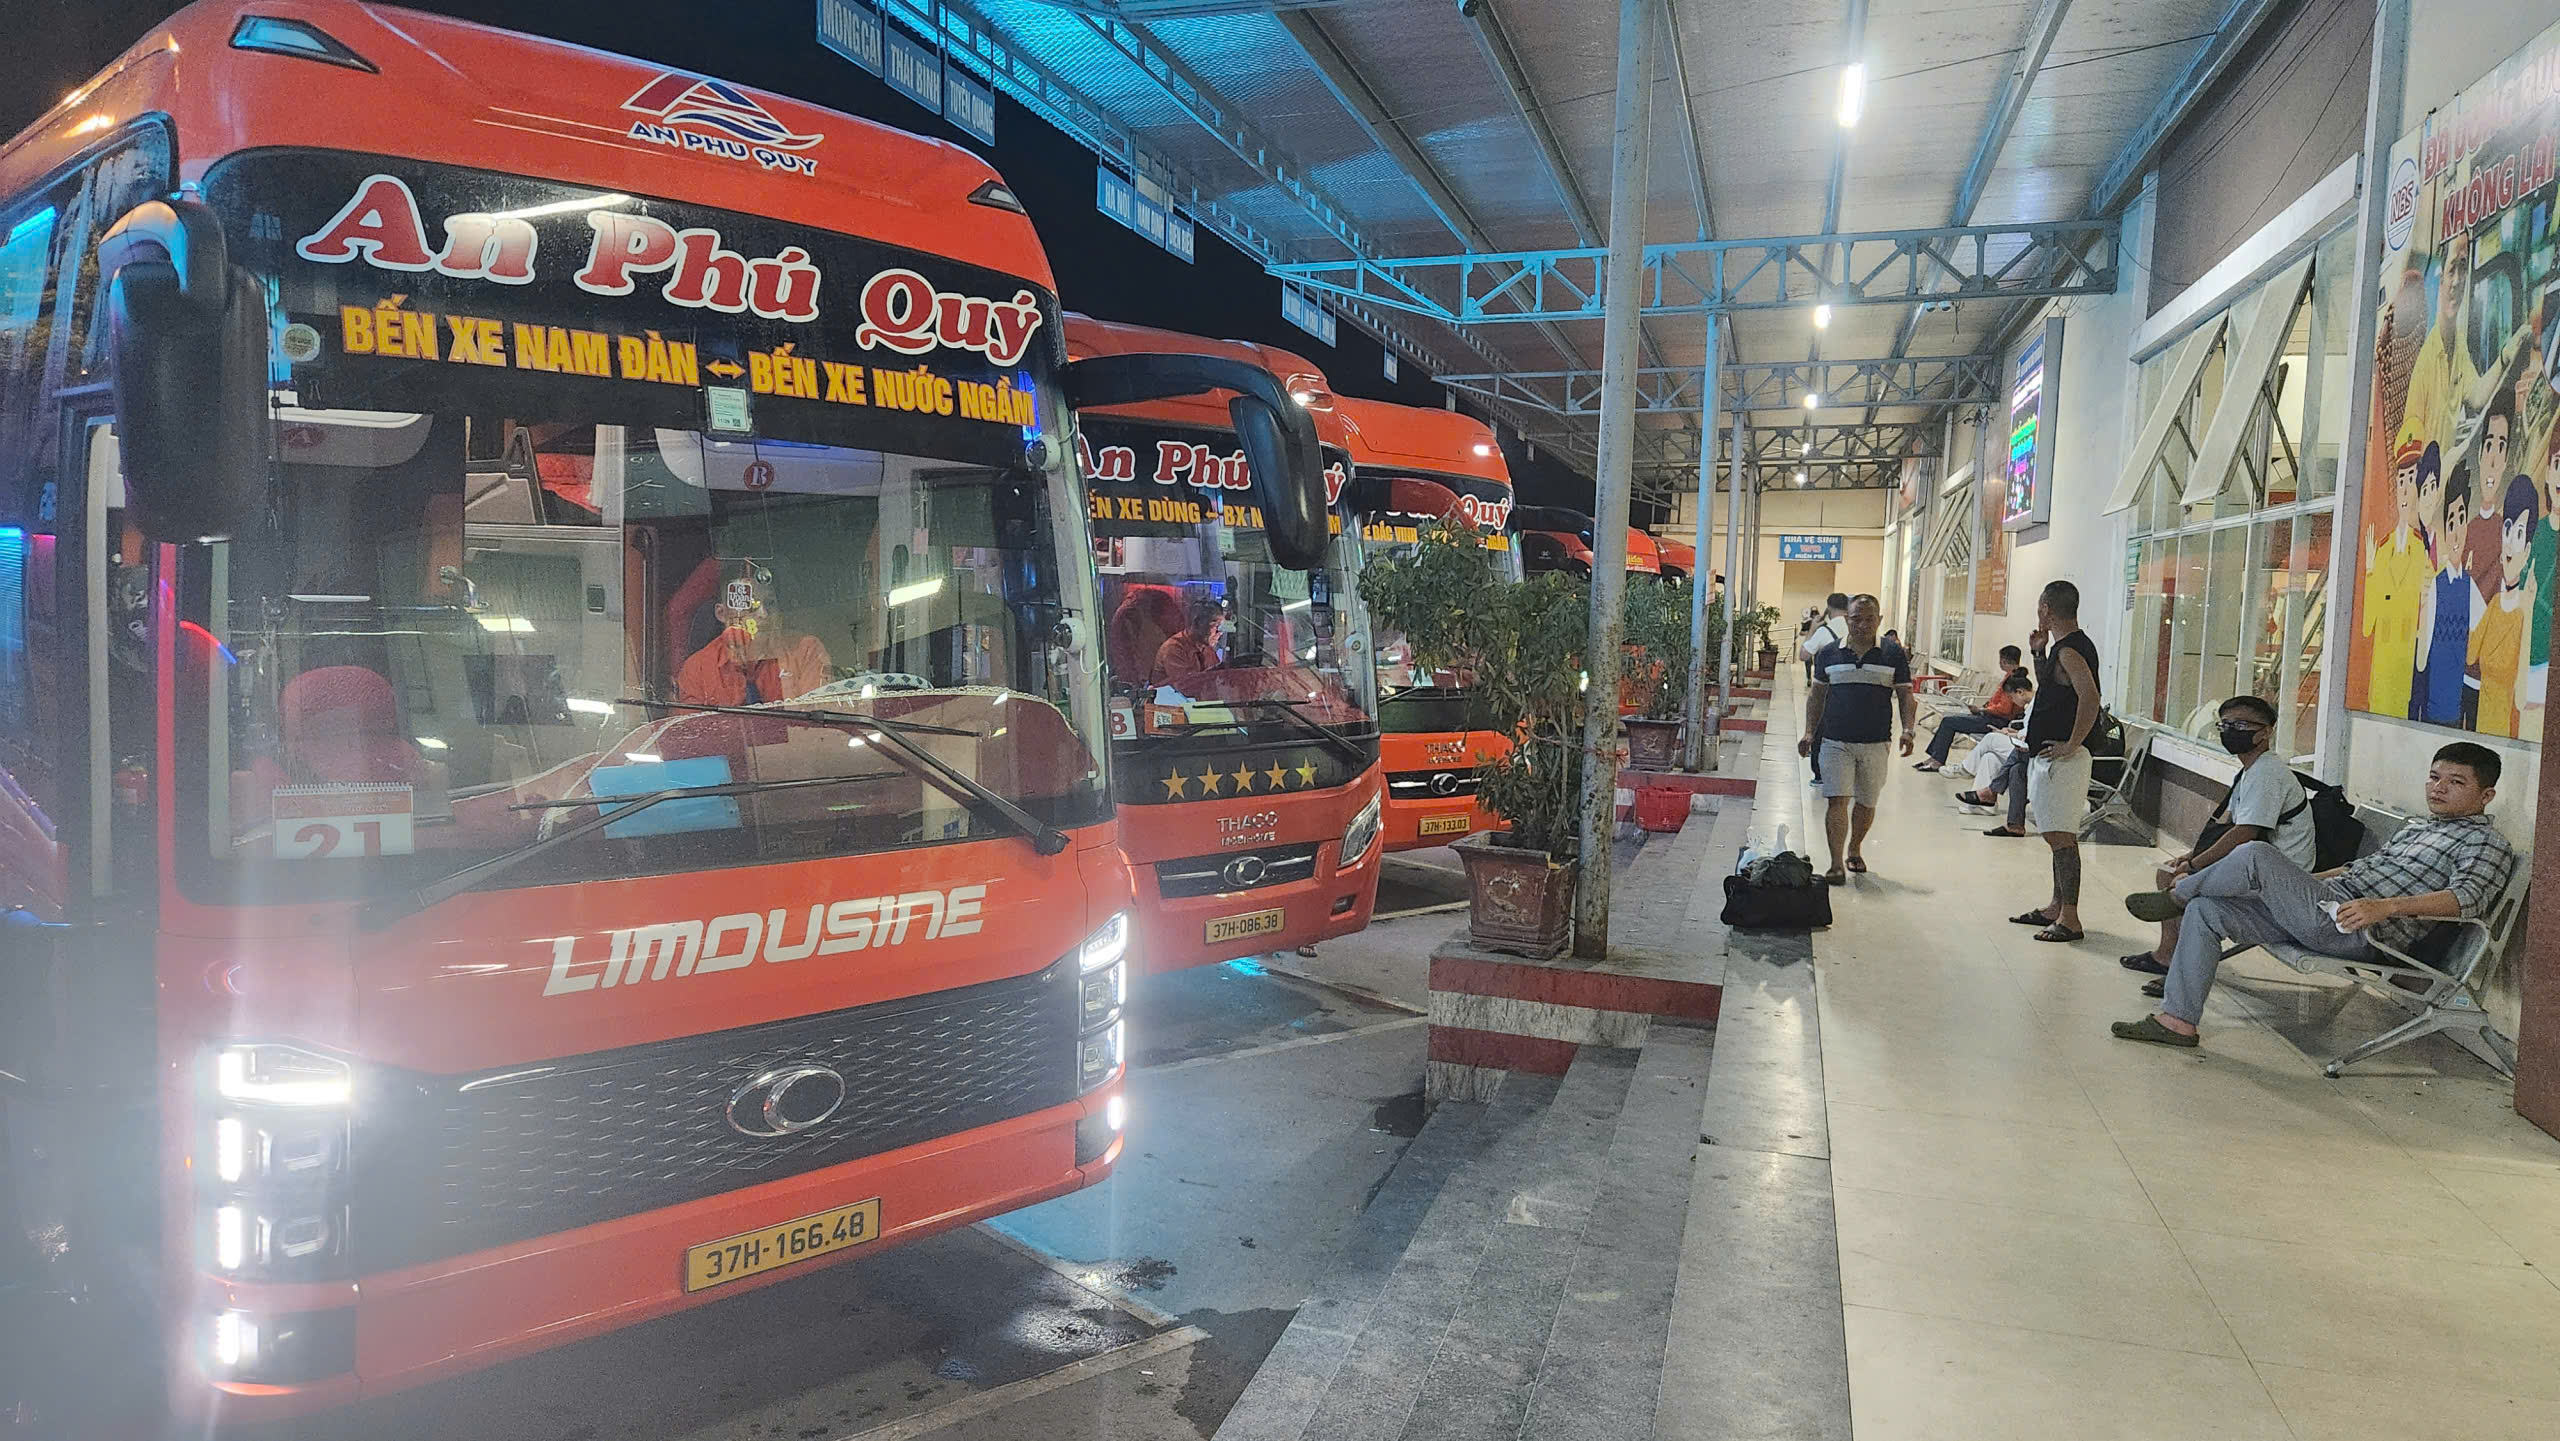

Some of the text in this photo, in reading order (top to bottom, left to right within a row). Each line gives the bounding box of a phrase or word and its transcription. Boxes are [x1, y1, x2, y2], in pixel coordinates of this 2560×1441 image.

[890, 43, 940, 106] THÁI BÌNH
[627, 120, 817, 177] AN PHU QUY
[2440, 154, 2515, 245] KHÔNG
[296, 174, 1043, 367] An Phú Quý
[340, 294, 1036, 427] BẾN XE NAM ĐÀN BẾN XE NƯỚC NGẦM
[1153, 441, 1252, 490] Phú
[1117, 497, 1144, 520] XE
[1149, 495, 1201, 524] DÙNG
[1223, 505, 1248, 528] BX
[294, 822, 381, 858] 21
[1216, 810, 1278, 833] THACO
[543, 884, 986, 997] LIMOUSINE
[706, 1211, 866, 1281] 37H-166.48
